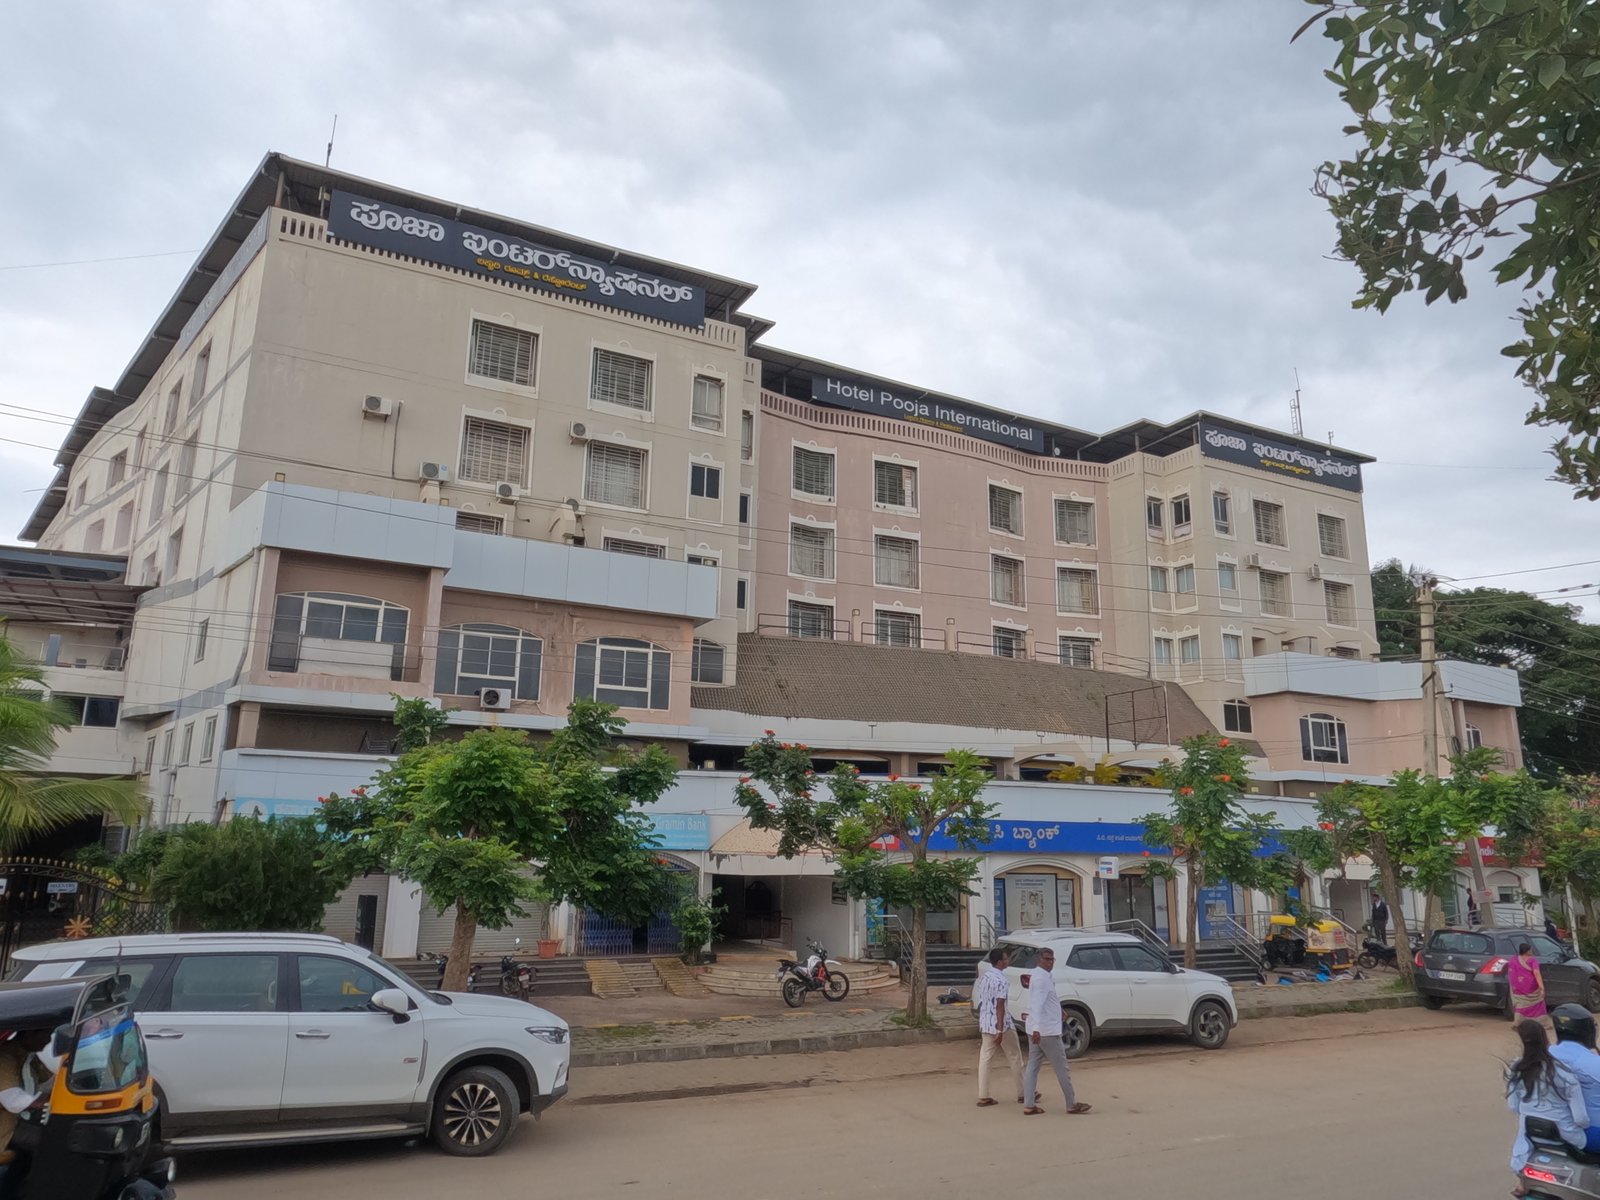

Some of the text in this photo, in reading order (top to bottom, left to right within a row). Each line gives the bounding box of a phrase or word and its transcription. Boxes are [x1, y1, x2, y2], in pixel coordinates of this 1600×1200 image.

[349, 200, 445, 242] ಪೂಜಾ
[826, 378, 1033, 441] Hotel Pooja International
[1204, 429, 1247, 451] ಪೂಜಾ
[687, 817, 706, 831] Bank
[1012, 824, 1060, 849] ಬ್ಯಾಂಕ್
